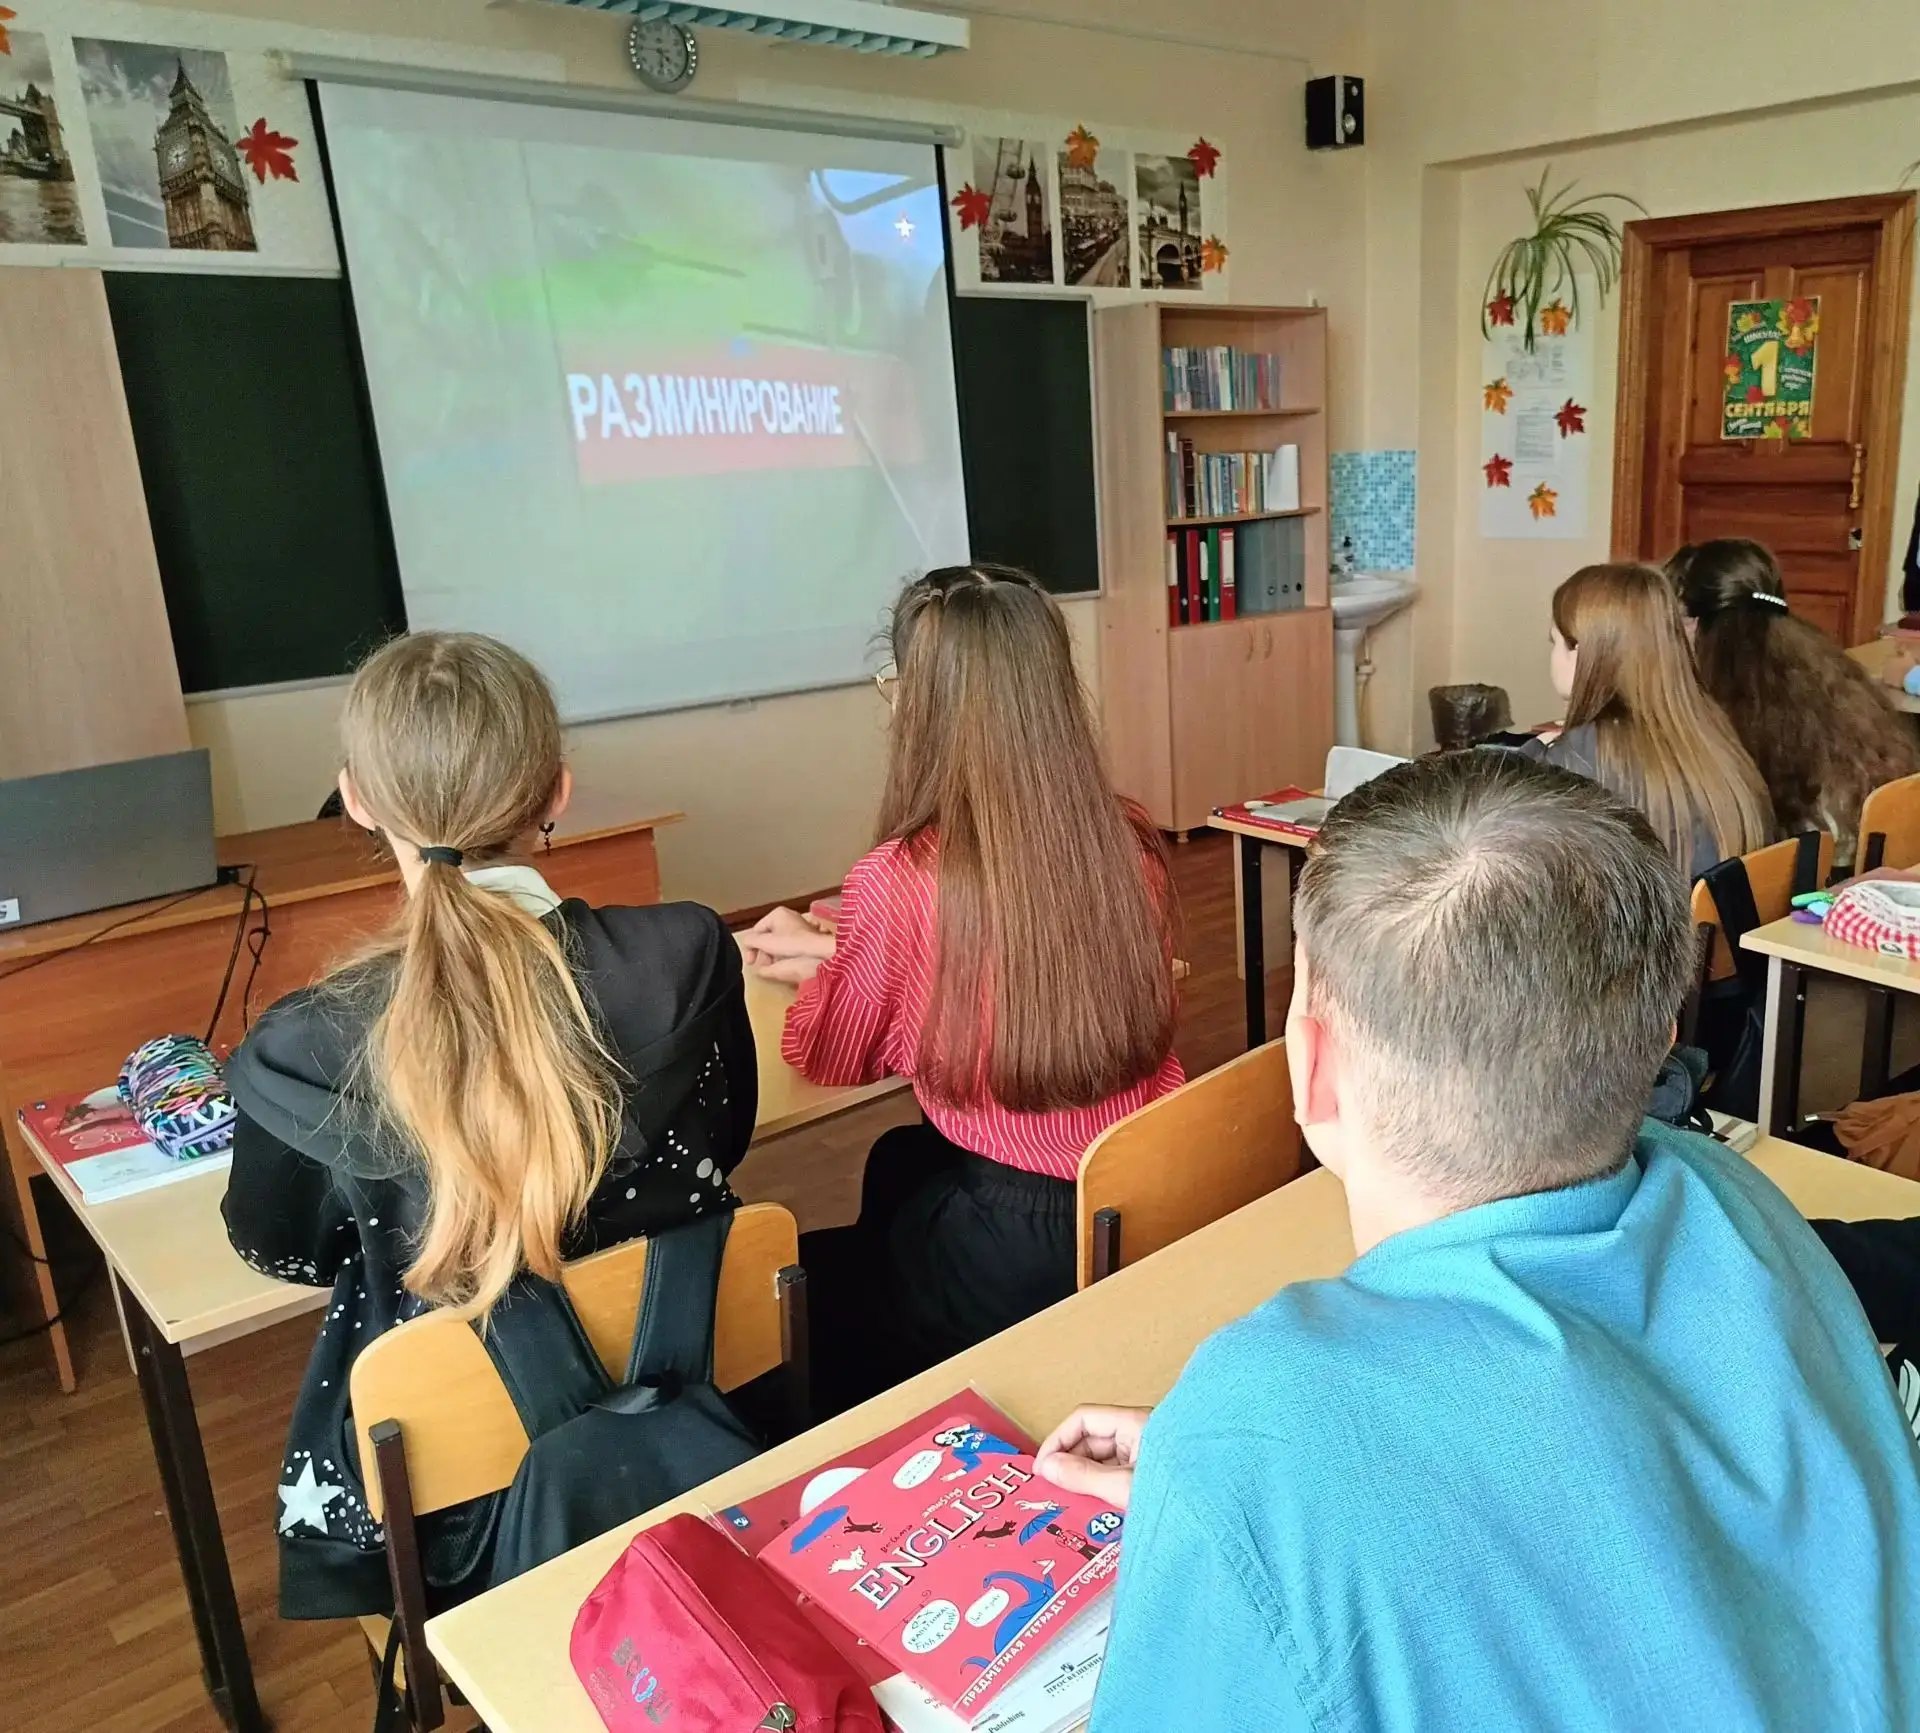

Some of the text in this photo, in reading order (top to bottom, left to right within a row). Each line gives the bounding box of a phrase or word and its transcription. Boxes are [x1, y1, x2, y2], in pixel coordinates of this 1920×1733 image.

[1751, 340, 1779, 396] 1
[566, 373, 845, 442] РАЗМИНИРОВАНИЕ
[922, 1488, 964, 1519] amusing
[1090, 1512, 1121, 1536] 48
[850, 1462, 1033, 1610] ENGLISH
[962, 1641, 1025, 1707] ПРЕДМЕТНАЯ
[1025, 1599, 1066, 1640] ТЕТРАДЬ
[988, 1709, 1026, 1733] Publishing
